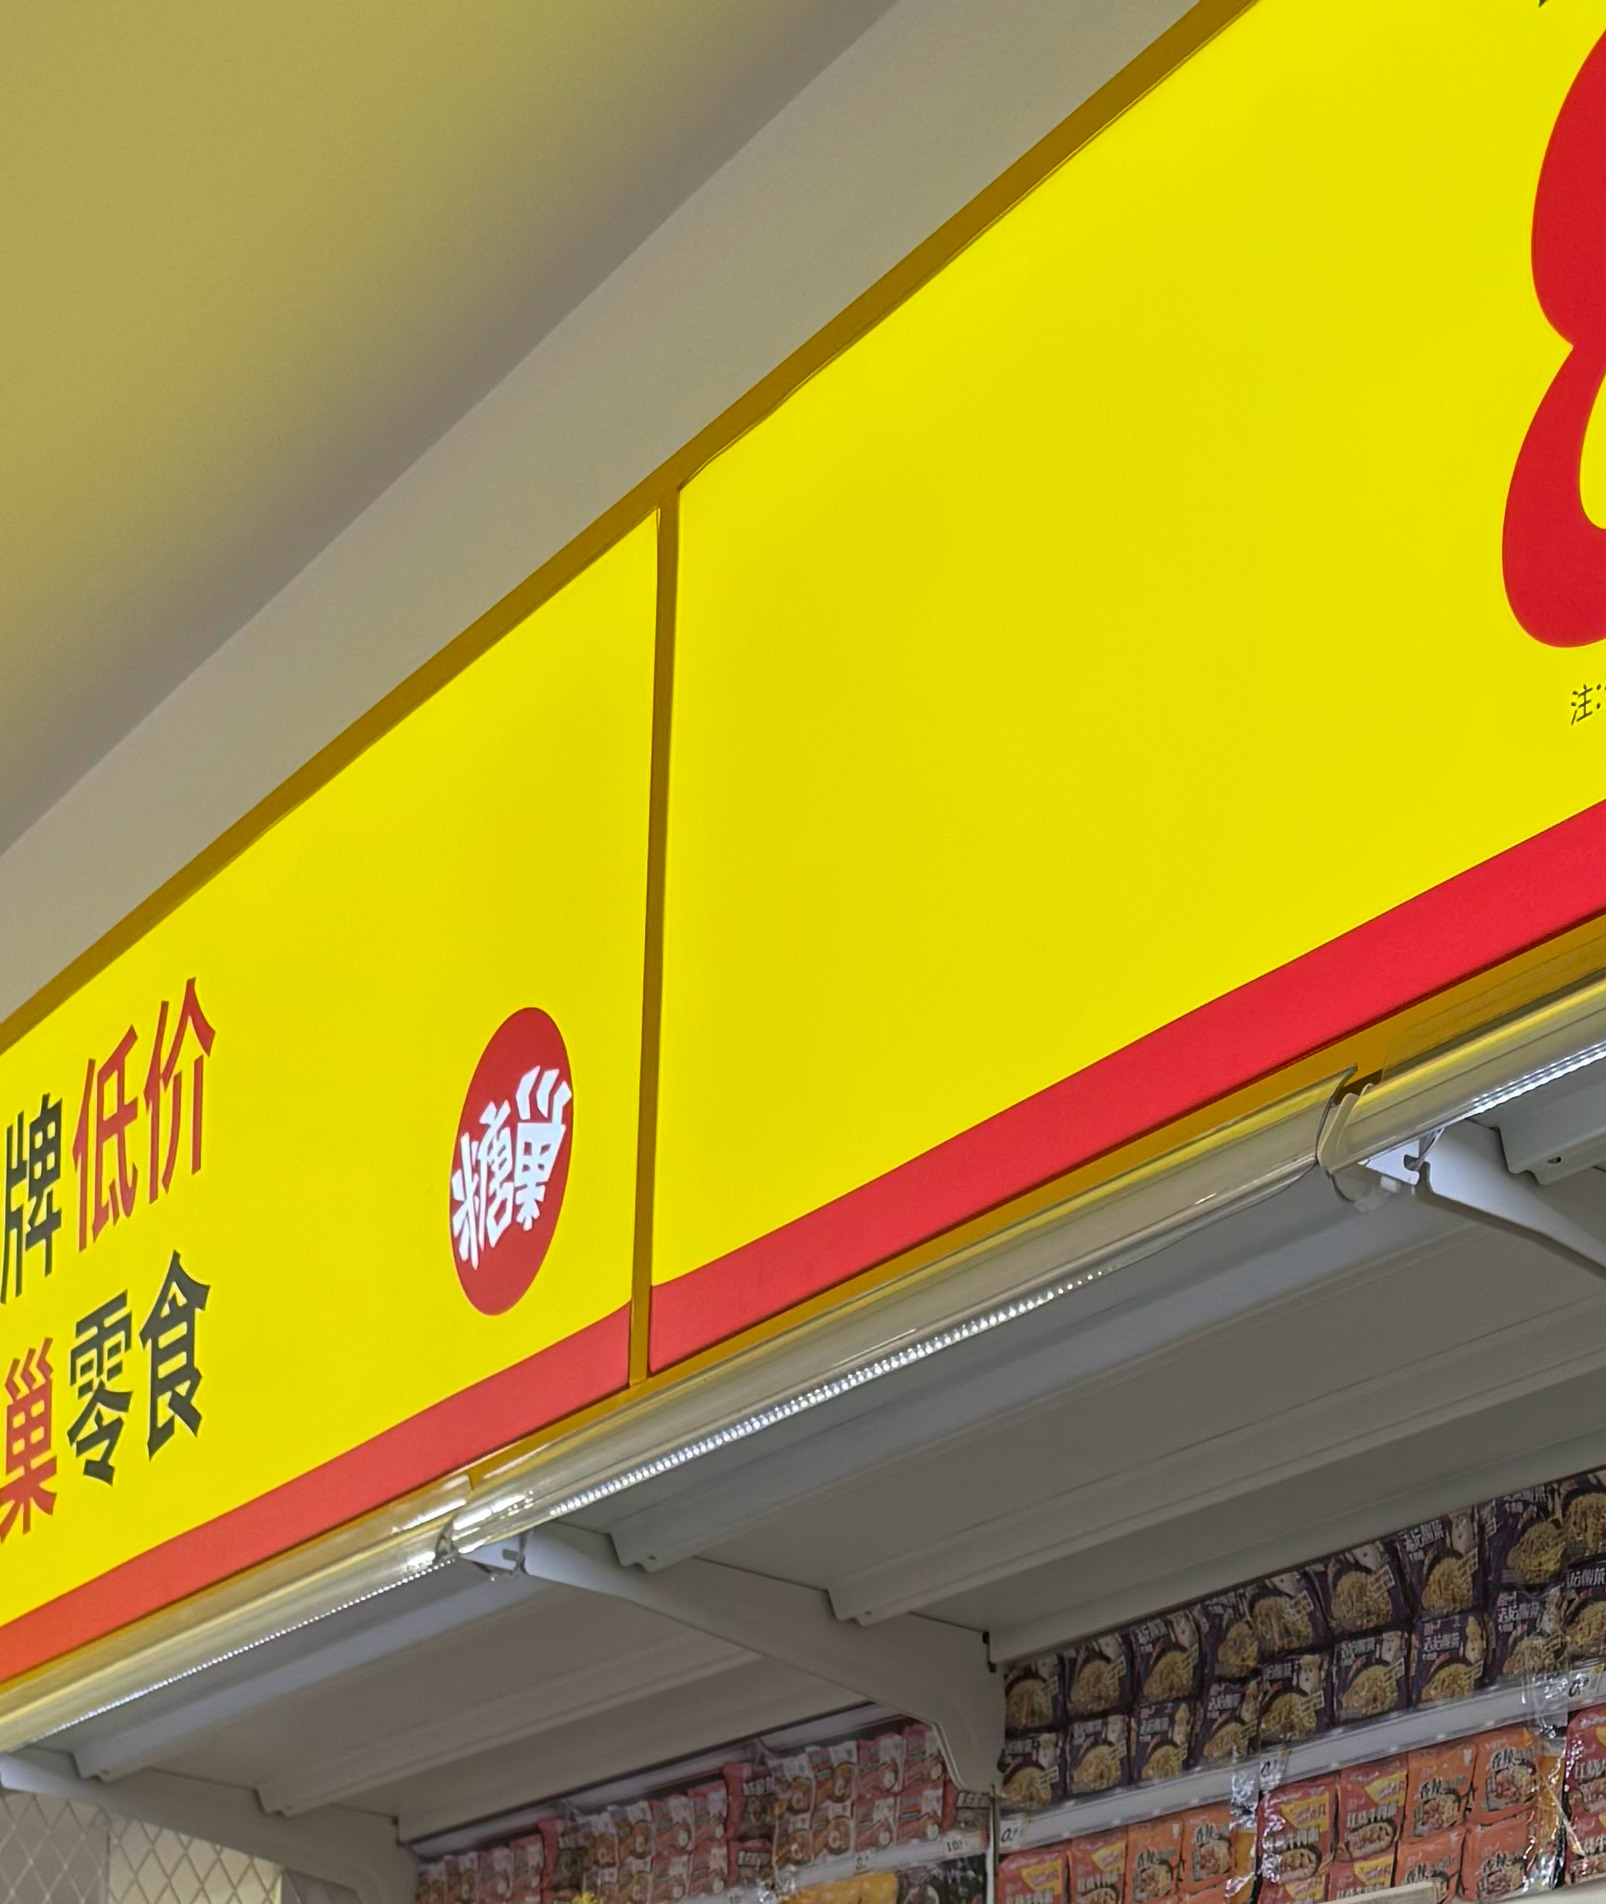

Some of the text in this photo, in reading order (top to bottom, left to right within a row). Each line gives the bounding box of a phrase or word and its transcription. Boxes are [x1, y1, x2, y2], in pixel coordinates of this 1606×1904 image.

[0, 977, 216, 1298] 牌低价
[451, 1065, 572, 1270] 糖巢
[0, 1250, 210, 1543] 巢零食
